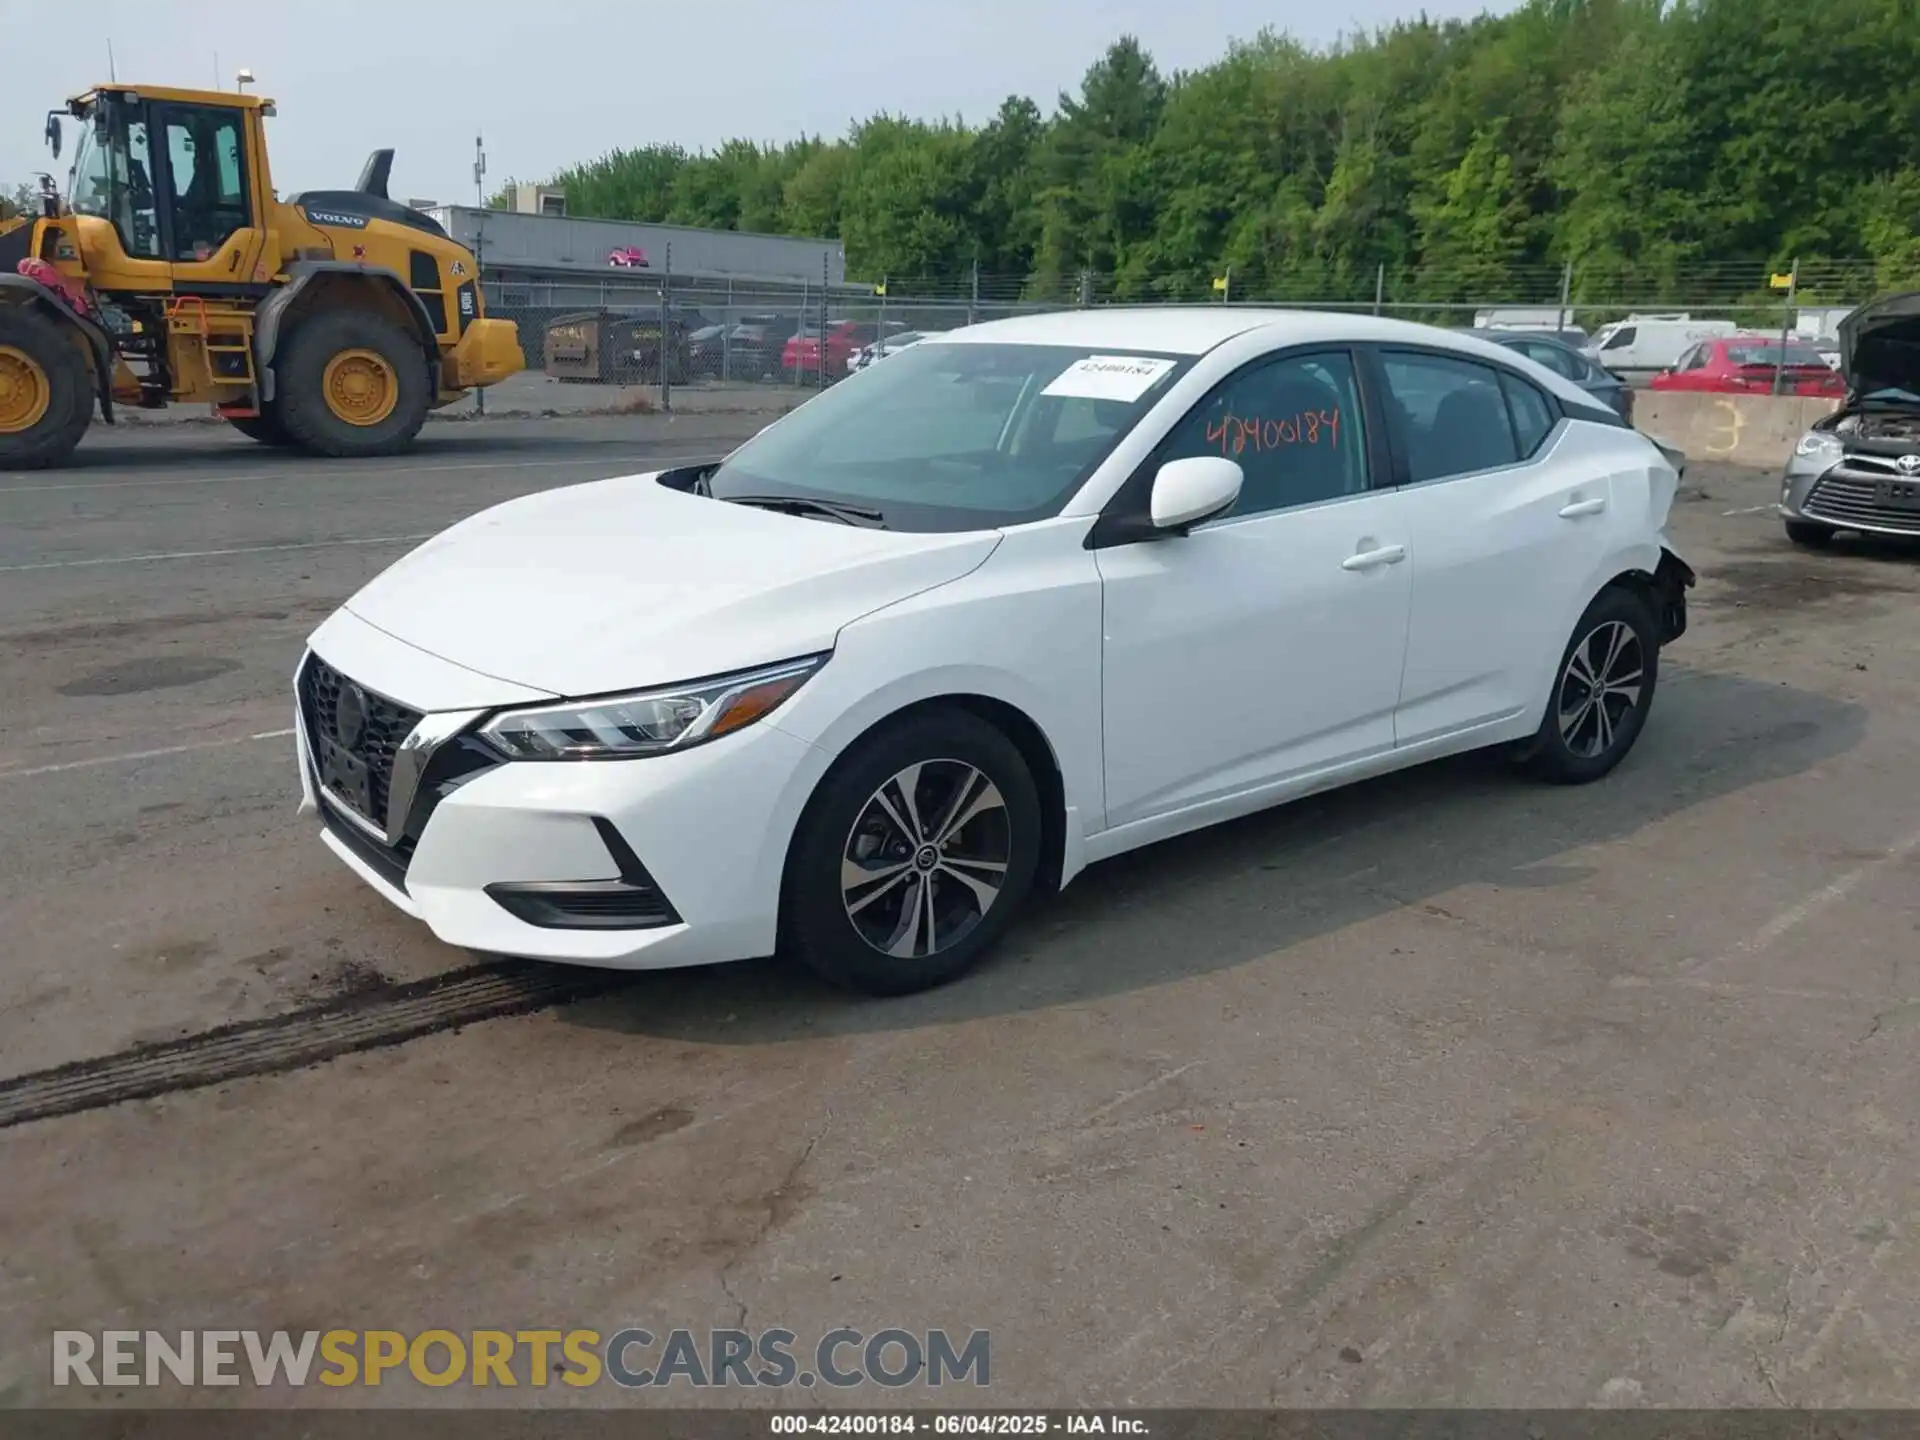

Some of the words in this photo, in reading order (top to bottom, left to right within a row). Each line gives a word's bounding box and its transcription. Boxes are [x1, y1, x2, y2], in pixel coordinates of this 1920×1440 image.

[310, 211, 365, 225] VOLVO
[1206, 407, 1339, 455] 42400184
[1705, 400, 1743, 452] 3
